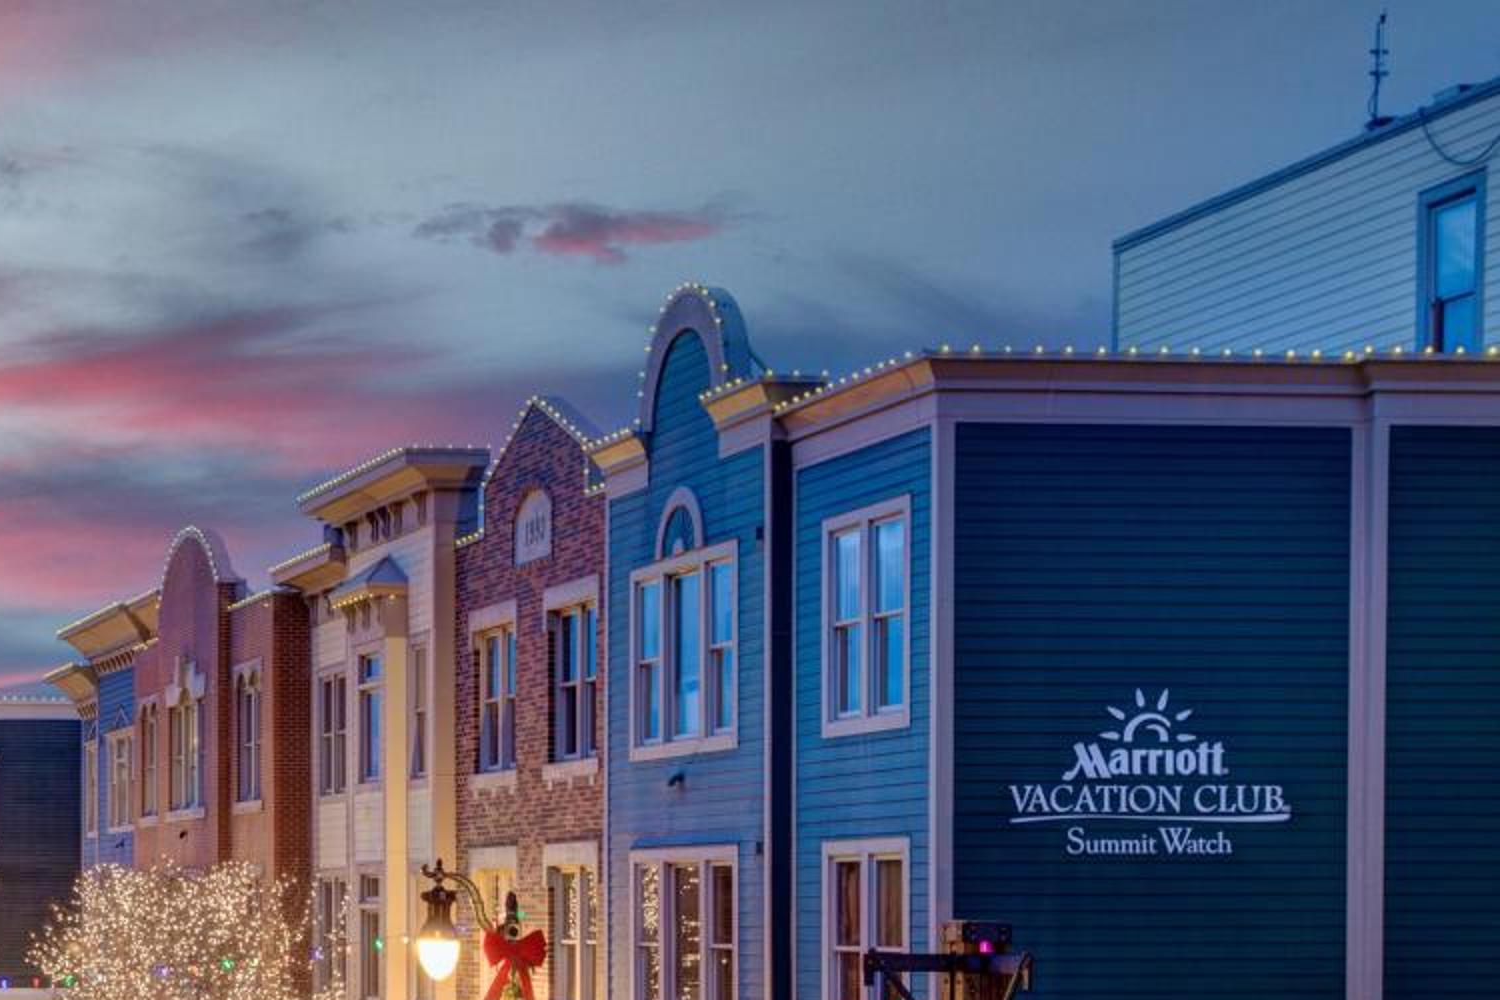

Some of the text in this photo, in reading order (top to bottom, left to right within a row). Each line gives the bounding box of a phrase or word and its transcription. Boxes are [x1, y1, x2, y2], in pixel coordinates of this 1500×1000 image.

[1062, 742, 1226, 781] Marriott
[1009, 784, 1285, 813] VACATION CLUB
[1066, 826, 1232, 854] Summit Watch
